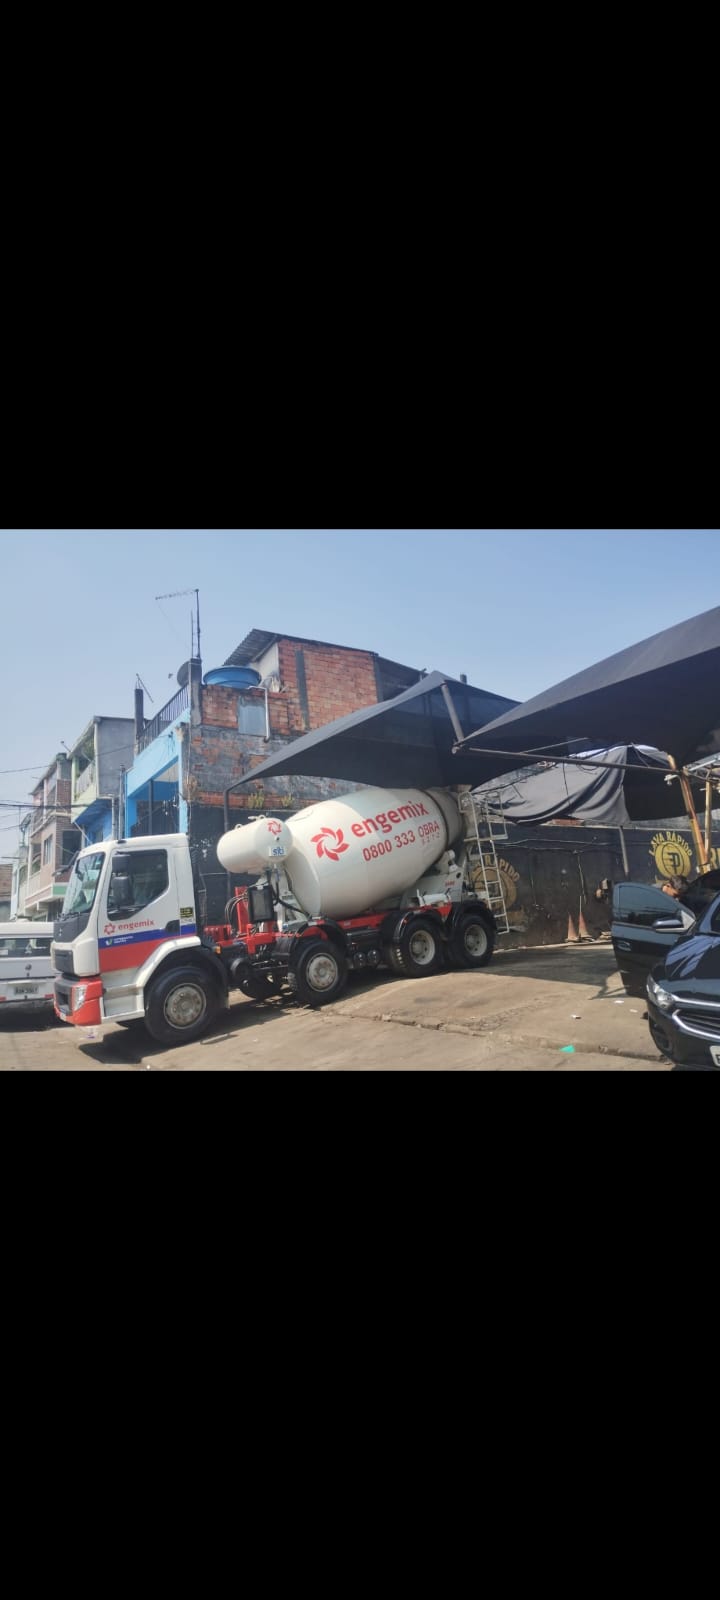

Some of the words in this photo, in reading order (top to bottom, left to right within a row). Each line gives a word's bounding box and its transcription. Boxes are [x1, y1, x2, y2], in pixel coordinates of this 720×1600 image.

[351, 800, 429, 838] engemix
[362, 839, 392, 862] 0800
[394, 830, 416, 848] 333
[417, 820, 440, 838] OBRA
[648, 832, 665, 857] LAVA
[117, 918, 155, 930] engemix
